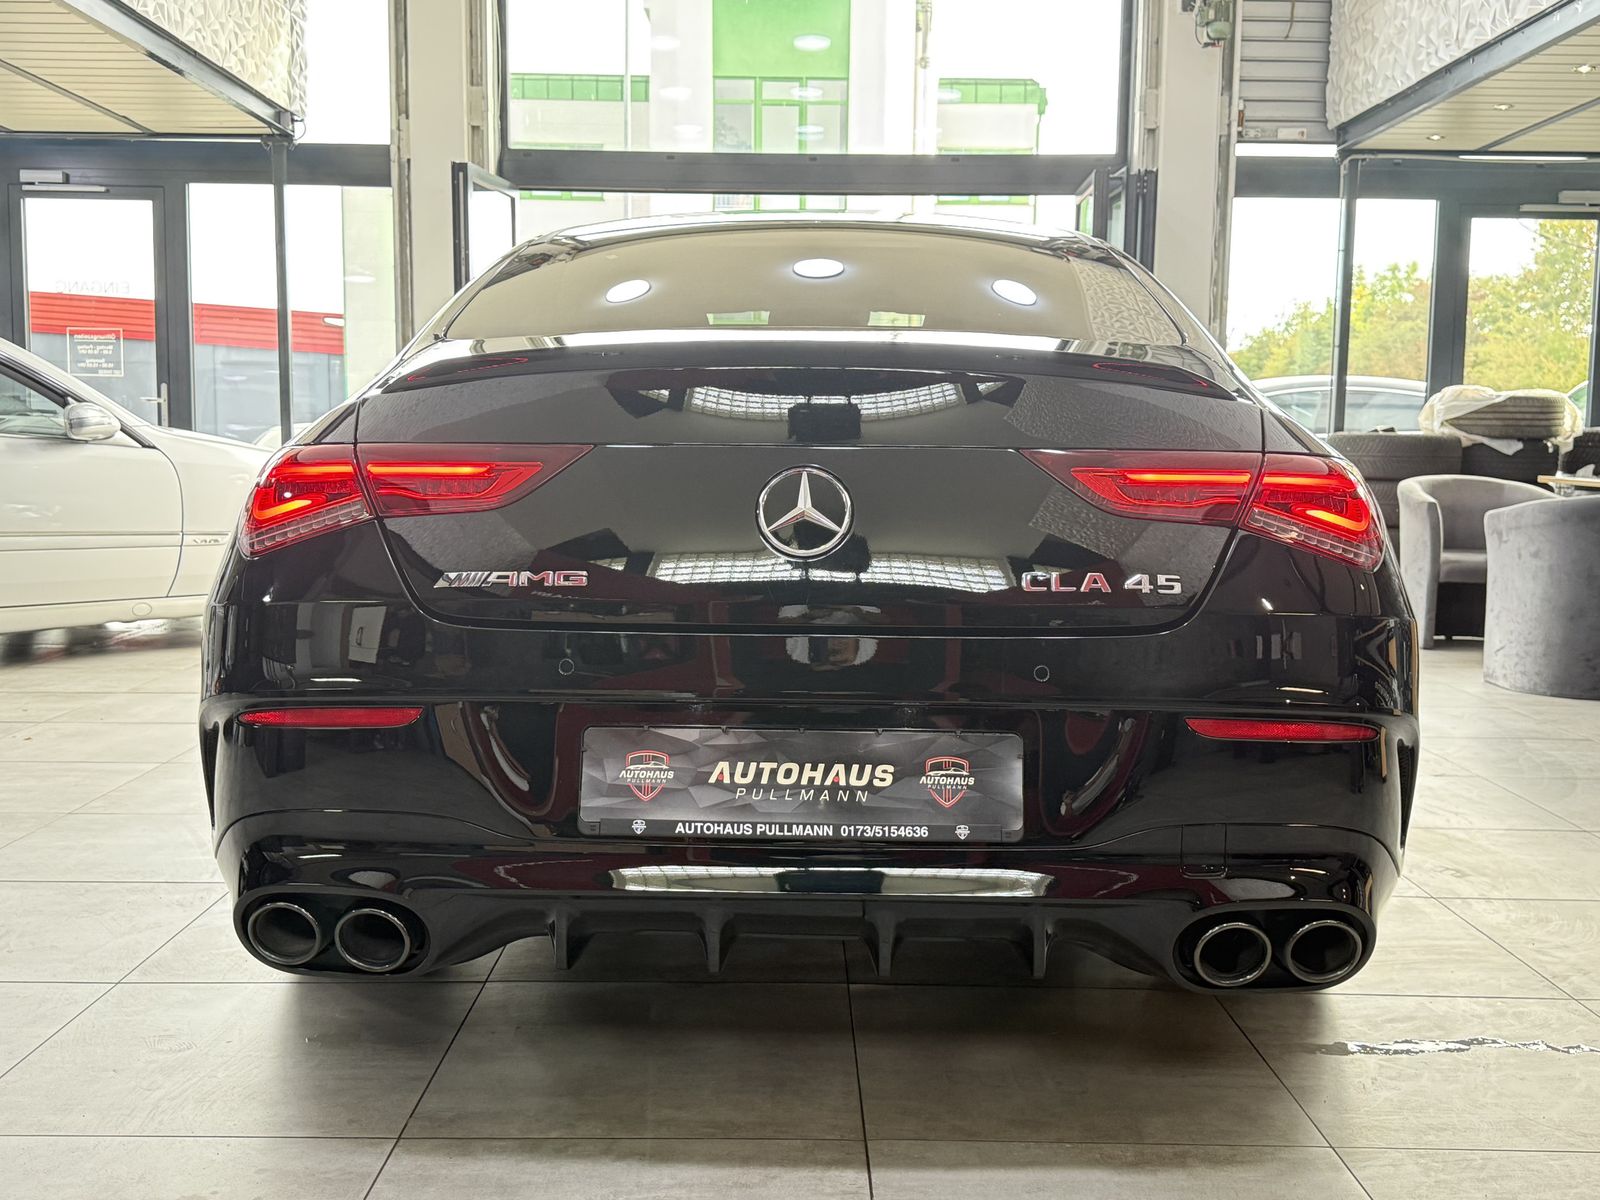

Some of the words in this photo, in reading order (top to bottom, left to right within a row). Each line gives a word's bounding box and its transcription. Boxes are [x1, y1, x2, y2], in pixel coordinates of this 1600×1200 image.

[482, 571, 588, 587] AMG
[1021, 571, 1112, 593] CLA
[1124, 573, 1183, 595] 45
[619, 770, 675, 779] AUTOHAUS
[708, 761, 895, 787] AUTOHAUS
[919, 776, 975, 785] AUTOHAUS
[735, 787, 868, 802] PULLMANN
[675, 822, 753, 835] AUTOHAUS
[756, 823, 833, 836] PULLMANN
[840, 825, 929, 838] 0173/5154636
